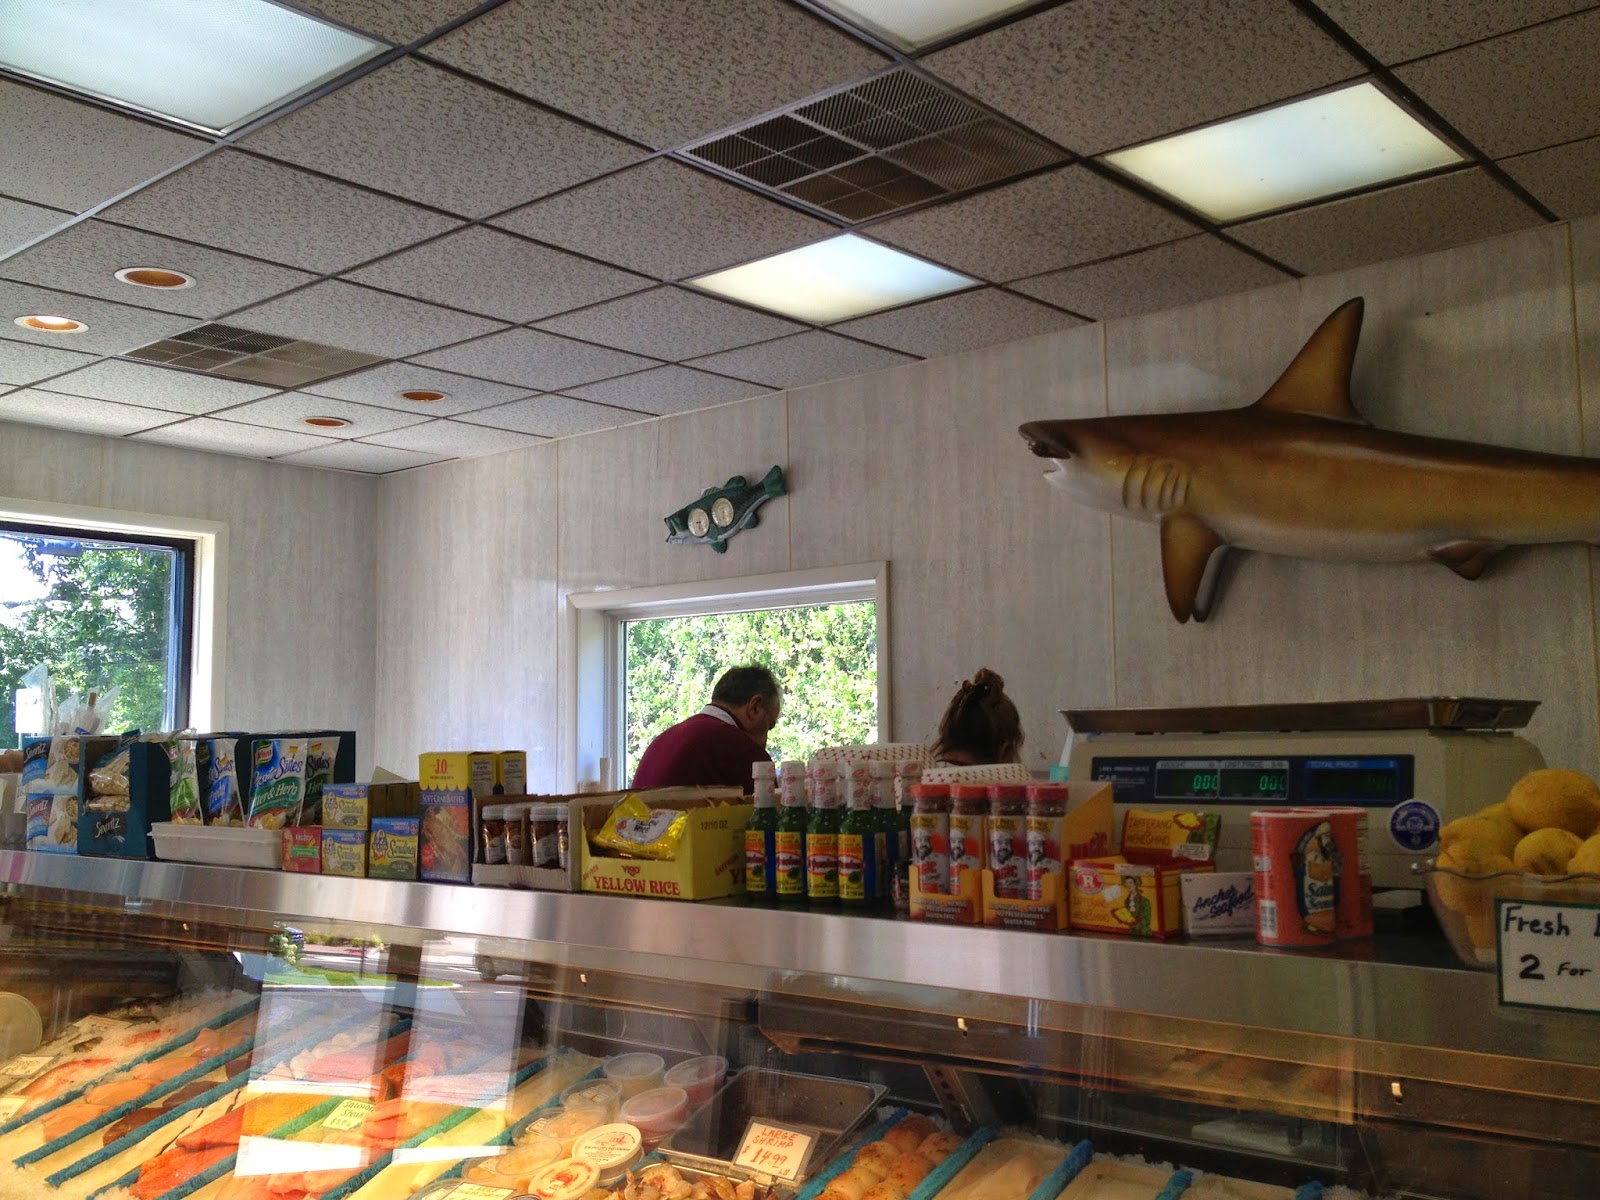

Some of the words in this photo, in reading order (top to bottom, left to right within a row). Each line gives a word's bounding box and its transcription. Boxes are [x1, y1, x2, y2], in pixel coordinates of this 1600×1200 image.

[274, 754, 303, 780] Sides
[434, 758, 449, 775] J.O.
[275, 782, 298, 797] Herb
[593, 876, 646, 893] YELLOW
[649, 879, 680, 895] RICE
[1082, 874, 1095, 889] R
[1504, 905, 1570, 937] Fresh
[1519, 953, 1545, 980] 2
[342, 1100, 375, 1113] Salmon
[752, 1135, 794, 1149] SHRIMP
[761, 1127, 799, 1142] LARGE
[749, 1148, 789, 1168] 14.99
